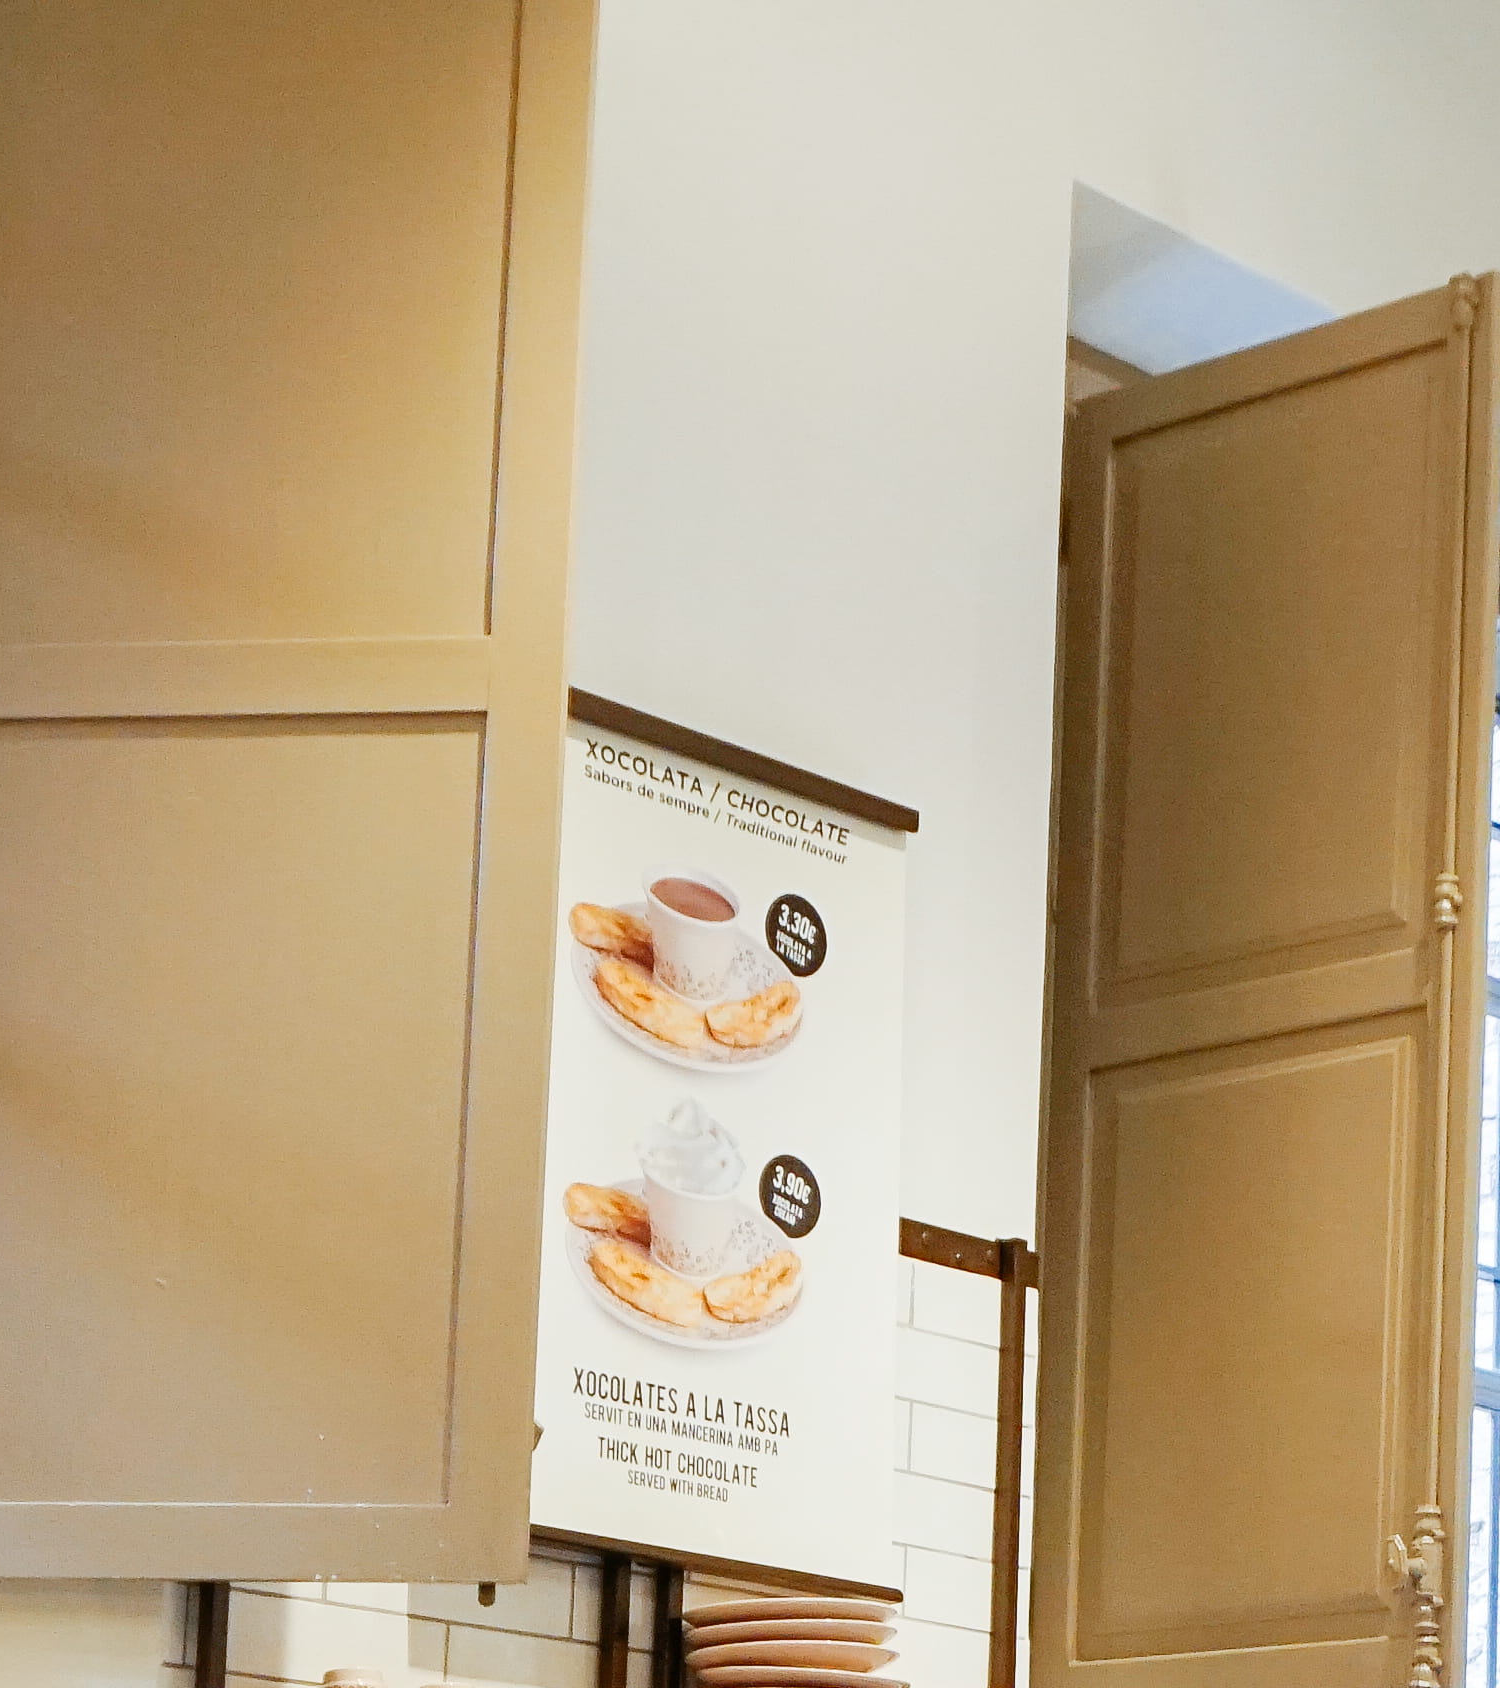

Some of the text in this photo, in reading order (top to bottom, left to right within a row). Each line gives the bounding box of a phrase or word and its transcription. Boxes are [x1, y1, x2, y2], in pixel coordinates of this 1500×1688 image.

[584, 764, 633, 792] Sabors
[637, 782, 655, 800] de
[659, 793, 710, 819] sempre
[726, 813, 798, 849] Traditional
[801, 839, 848, 865] flavour
[585, 738, 850, 846] XOCOLATA / CHOCOLATE
[573, 1366, 790, 1438] XOCOLATES A LA TASSA
[584, 1401, 779, 1457] SERVIT EN UNA MANCERINA AMB PA
[598, 1435, 759, 1488] THICK HOT CHOCOLATE
[627, 1469, 728, 1503] SERVED WITH BREAD
